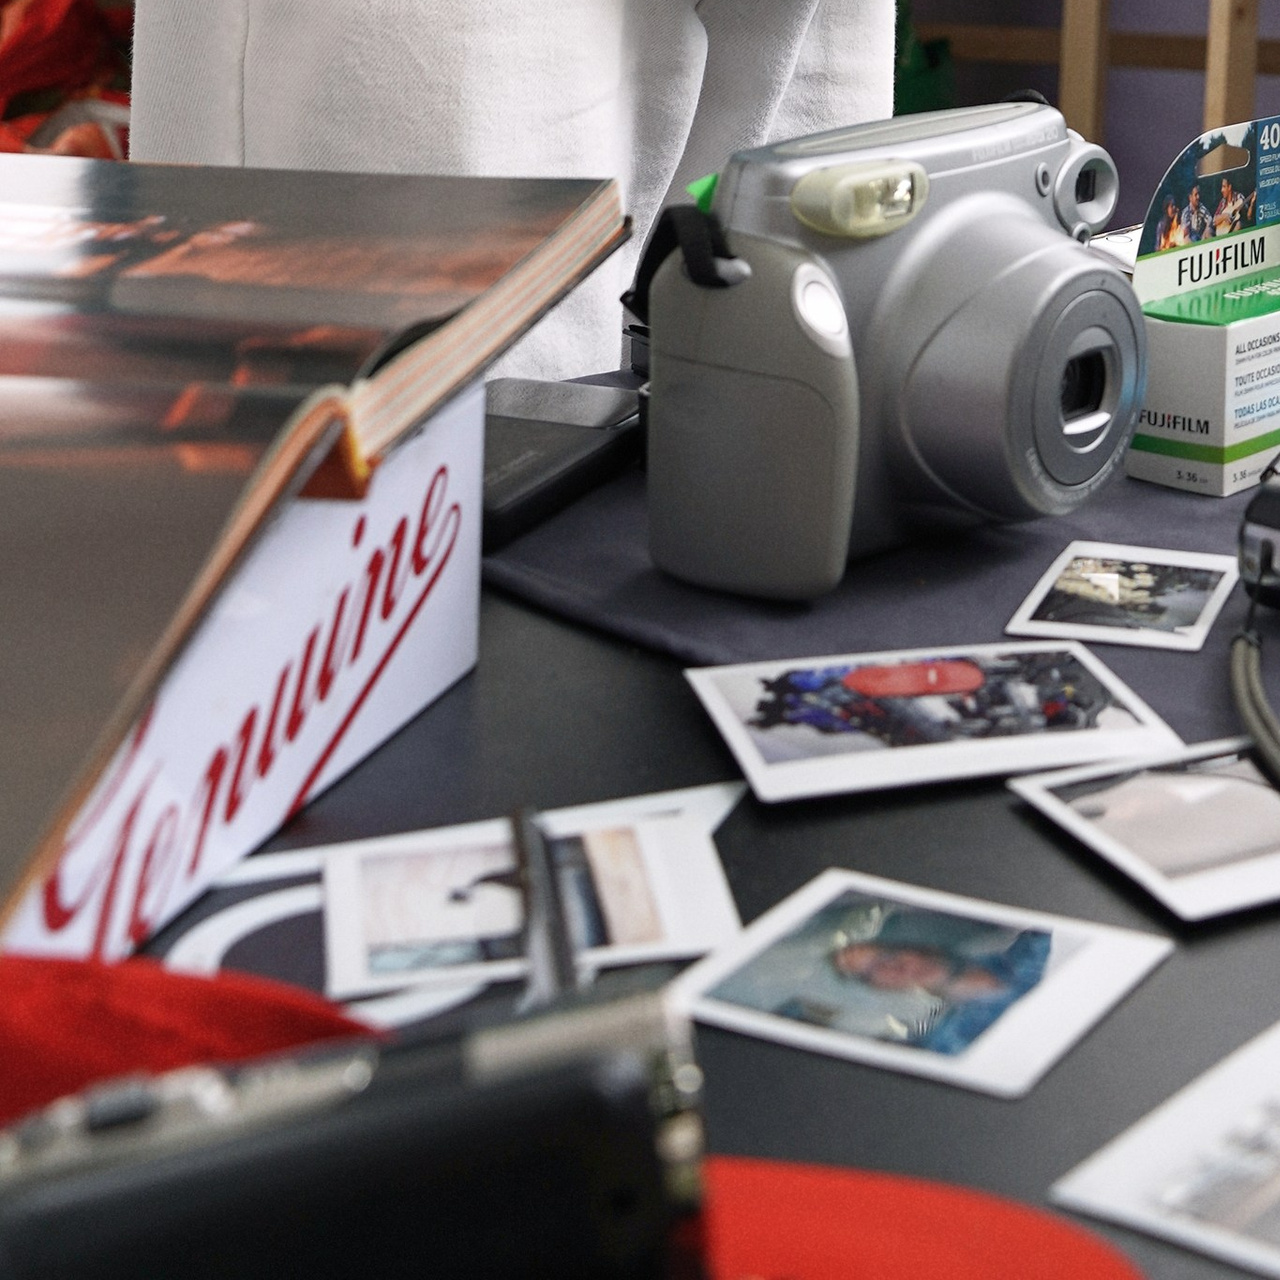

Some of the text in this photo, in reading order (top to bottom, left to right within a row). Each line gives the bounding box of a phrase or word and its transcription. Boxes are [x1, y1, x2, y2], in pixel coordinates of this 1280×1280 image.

[1259, 204, 1264, 220] 3
[1178, 236, 1265, 286] FUJIFILM
[1235, 342, 1246, 355] ALL
[1247, 332, 1280, 352] OCCASIONS
[1235, 372, 1254, 387] TOUTE
[1234, 403, 1255, 419] TODAS
[1256, 399, 1267, 412] LAS
[1139, 410, 1209, 434] FUJIFILM
[1186, 472, 1198, 482] 36
